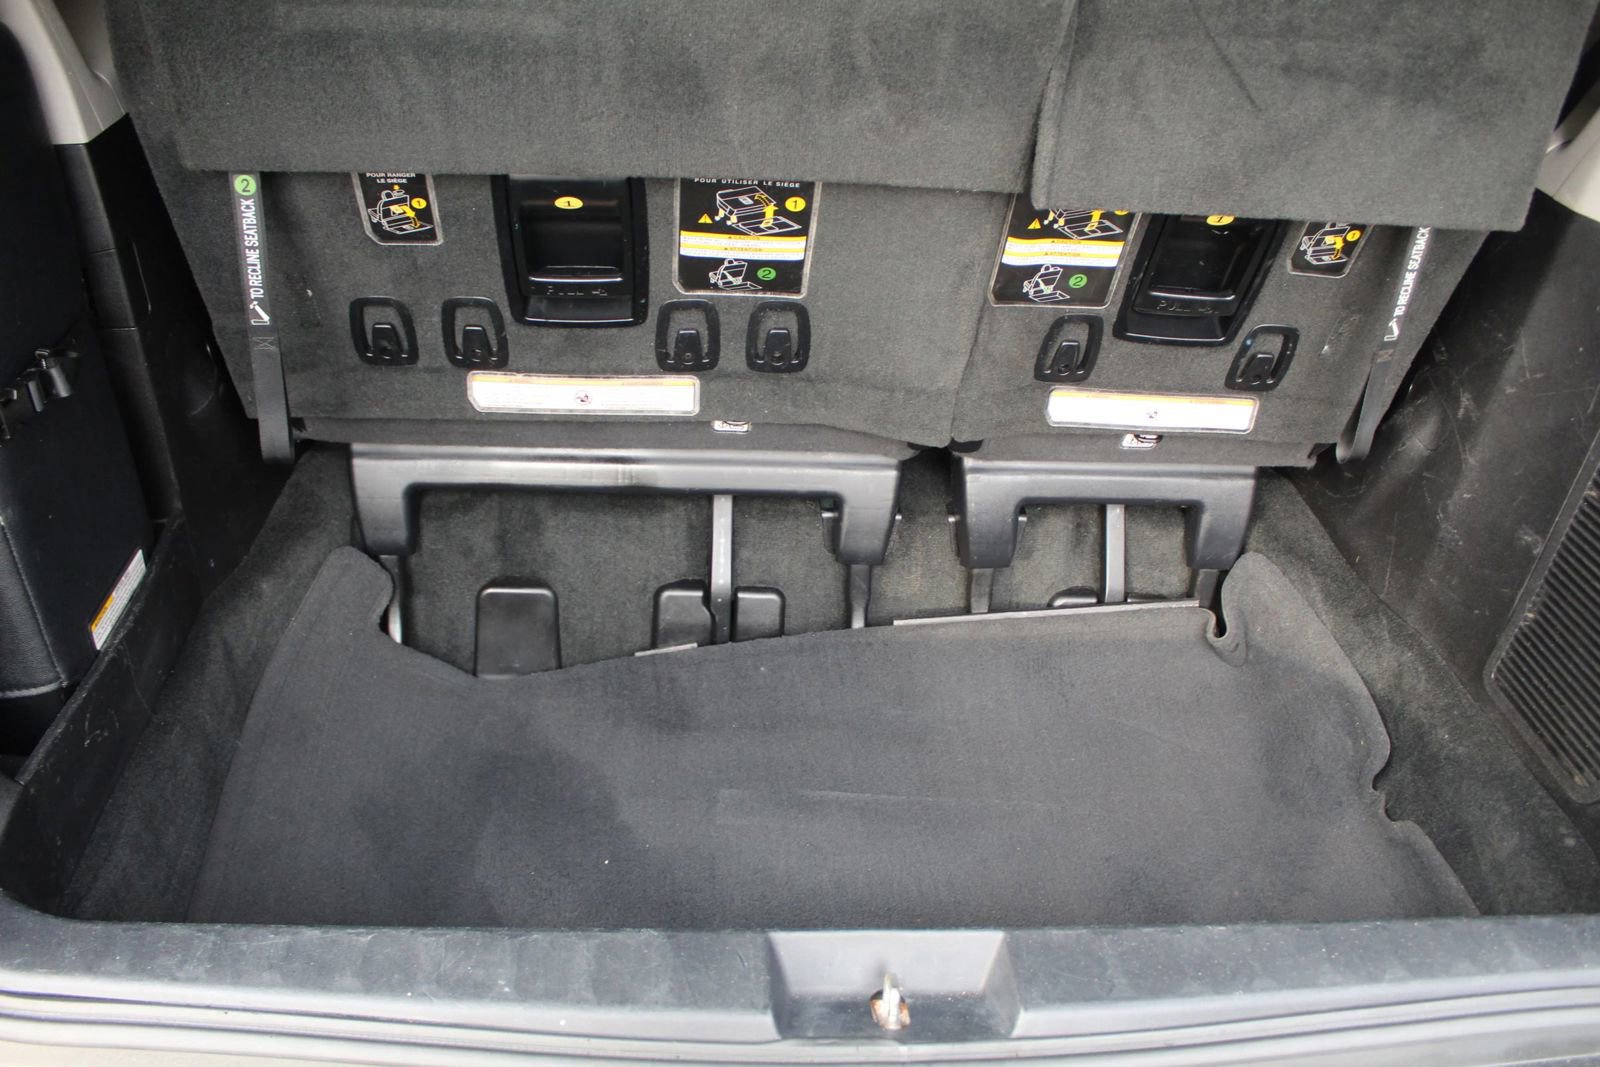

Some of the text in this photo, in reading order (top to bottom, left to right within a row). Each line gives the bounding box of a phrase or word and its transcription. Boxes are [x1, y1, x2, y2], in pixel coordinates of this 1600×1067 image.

[240, 178, 251, 193] 2
[240, 198, 265, 299] TO RECLINE SEATBACK
[762, 269, 772, 279] 2
[1393, 226, 1431, 317] TO RECLINE SEATBACK
[1073, 276, 1084, 287] 2
